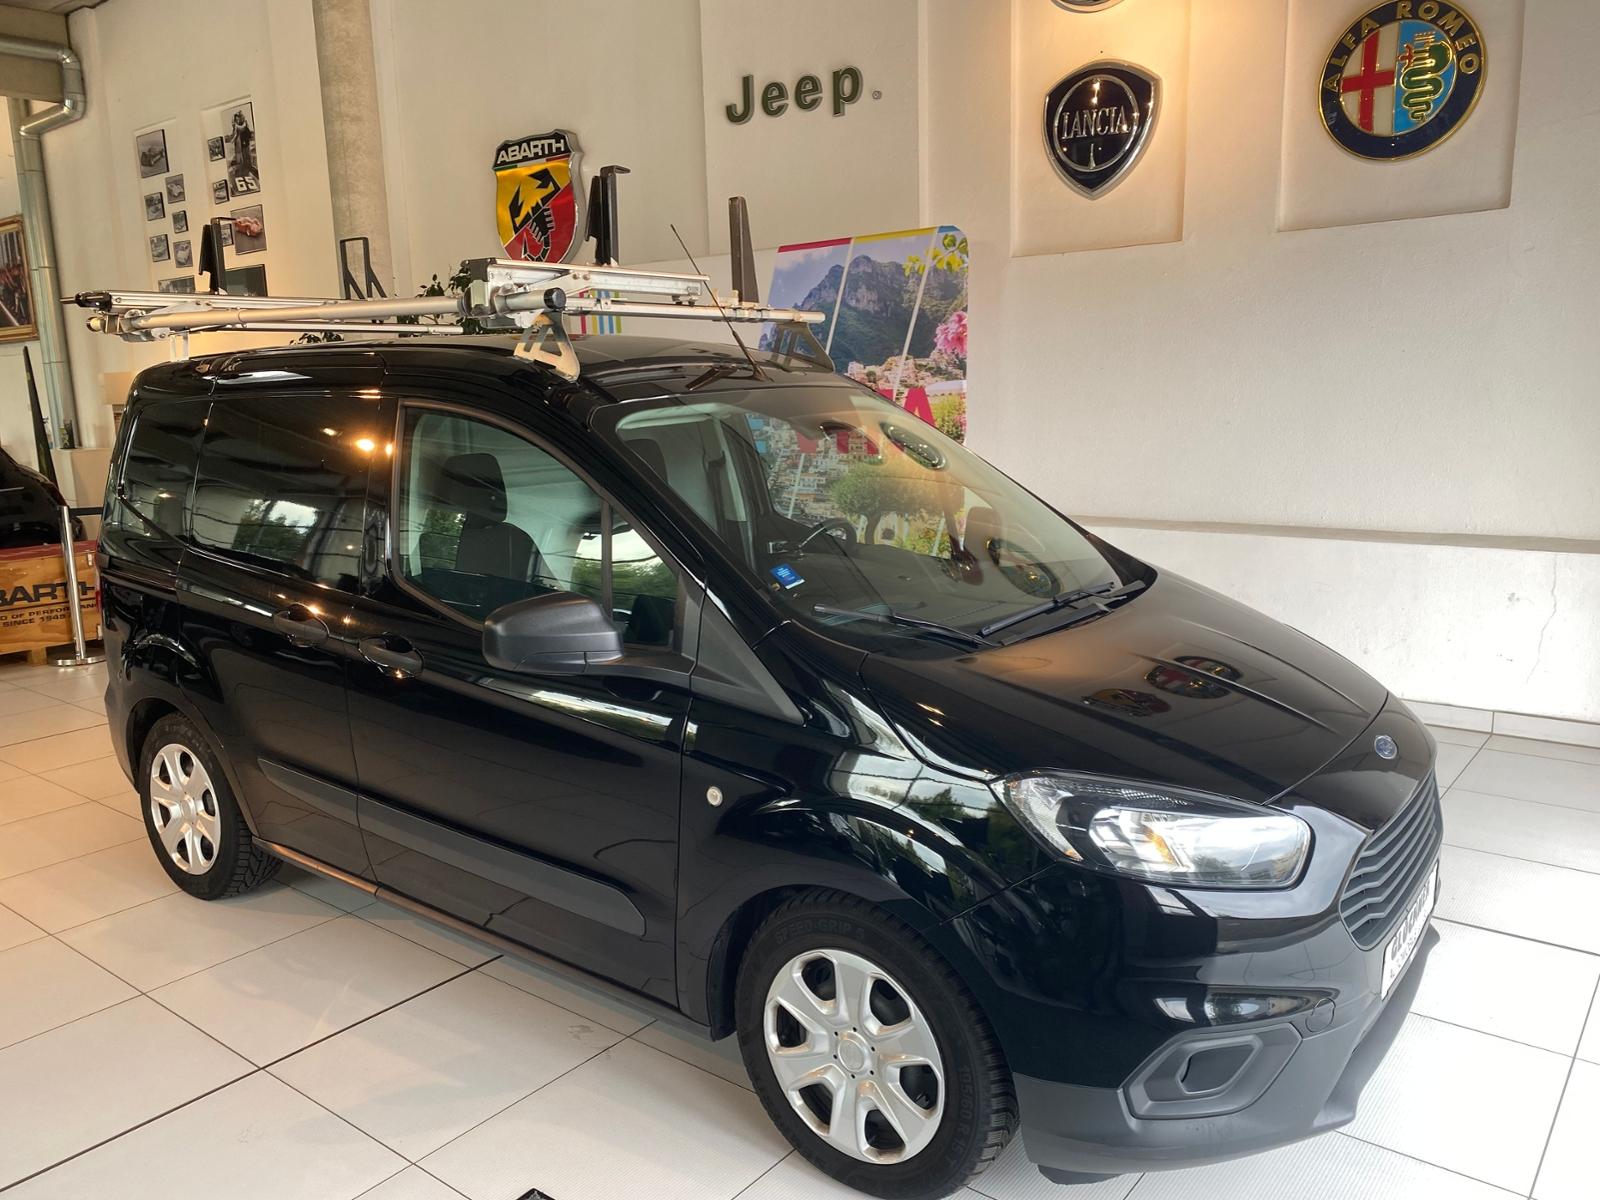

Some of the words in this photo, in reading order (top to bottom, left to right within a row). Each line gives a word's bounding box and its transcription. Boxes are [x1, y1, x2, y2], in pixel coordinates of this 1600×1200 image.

[1323, 17, 1380, 92] ALFA
[1397, 1, 1479, 74] ROMEO
[725, 65, 863, 125] Jeep
[1061, 105, 1131, 139] LANCIA
[497, 139, 565, 164] ABARTH
[235, 176, 258, 192] 65
[2, 618, 36, 628] SINCE
